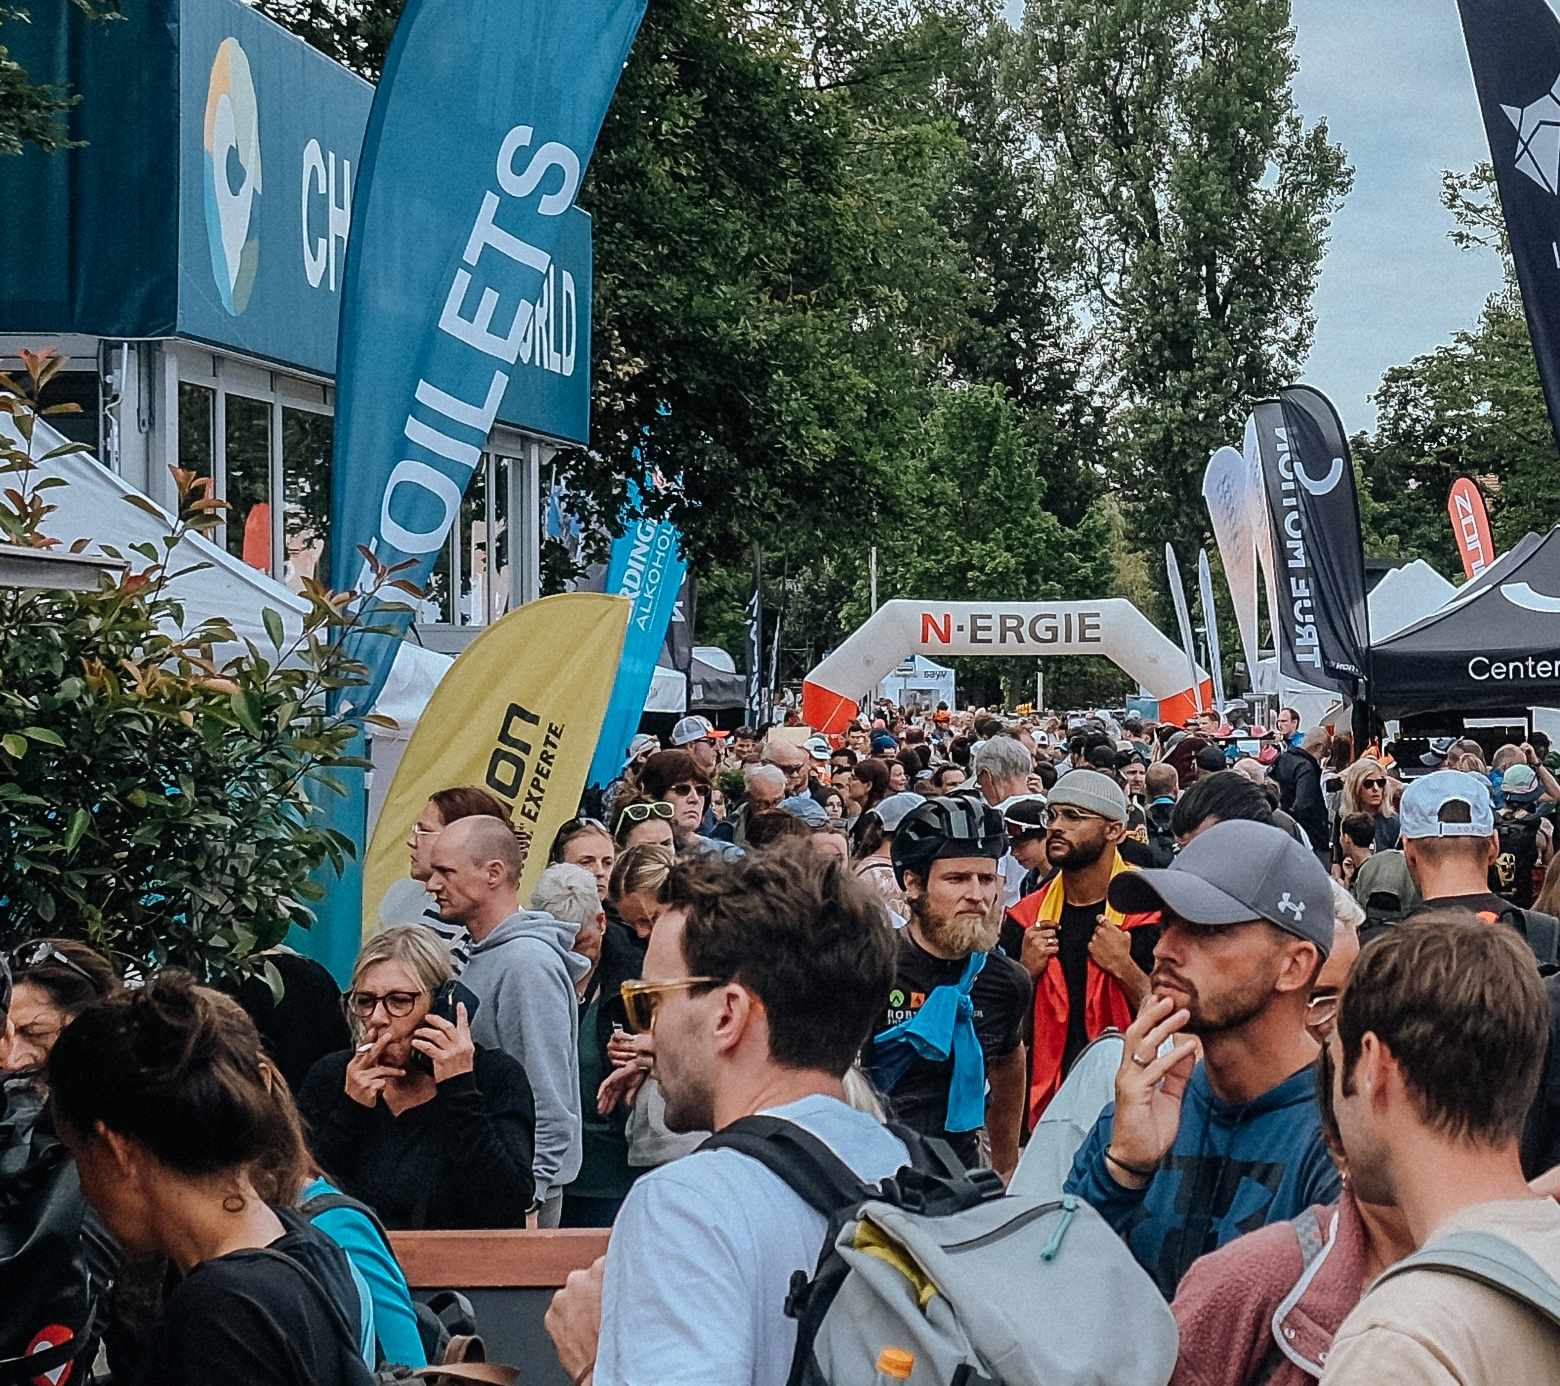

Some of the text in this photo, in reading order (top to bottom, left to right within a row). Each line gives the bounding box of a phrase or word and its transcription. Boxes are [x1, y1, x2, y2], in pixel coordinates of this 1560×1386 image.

[346, 124, 581, 616] TOILETS
[521, 263, 576, 377] RLD
[635, 524, 675, 632] ALKOHOL
